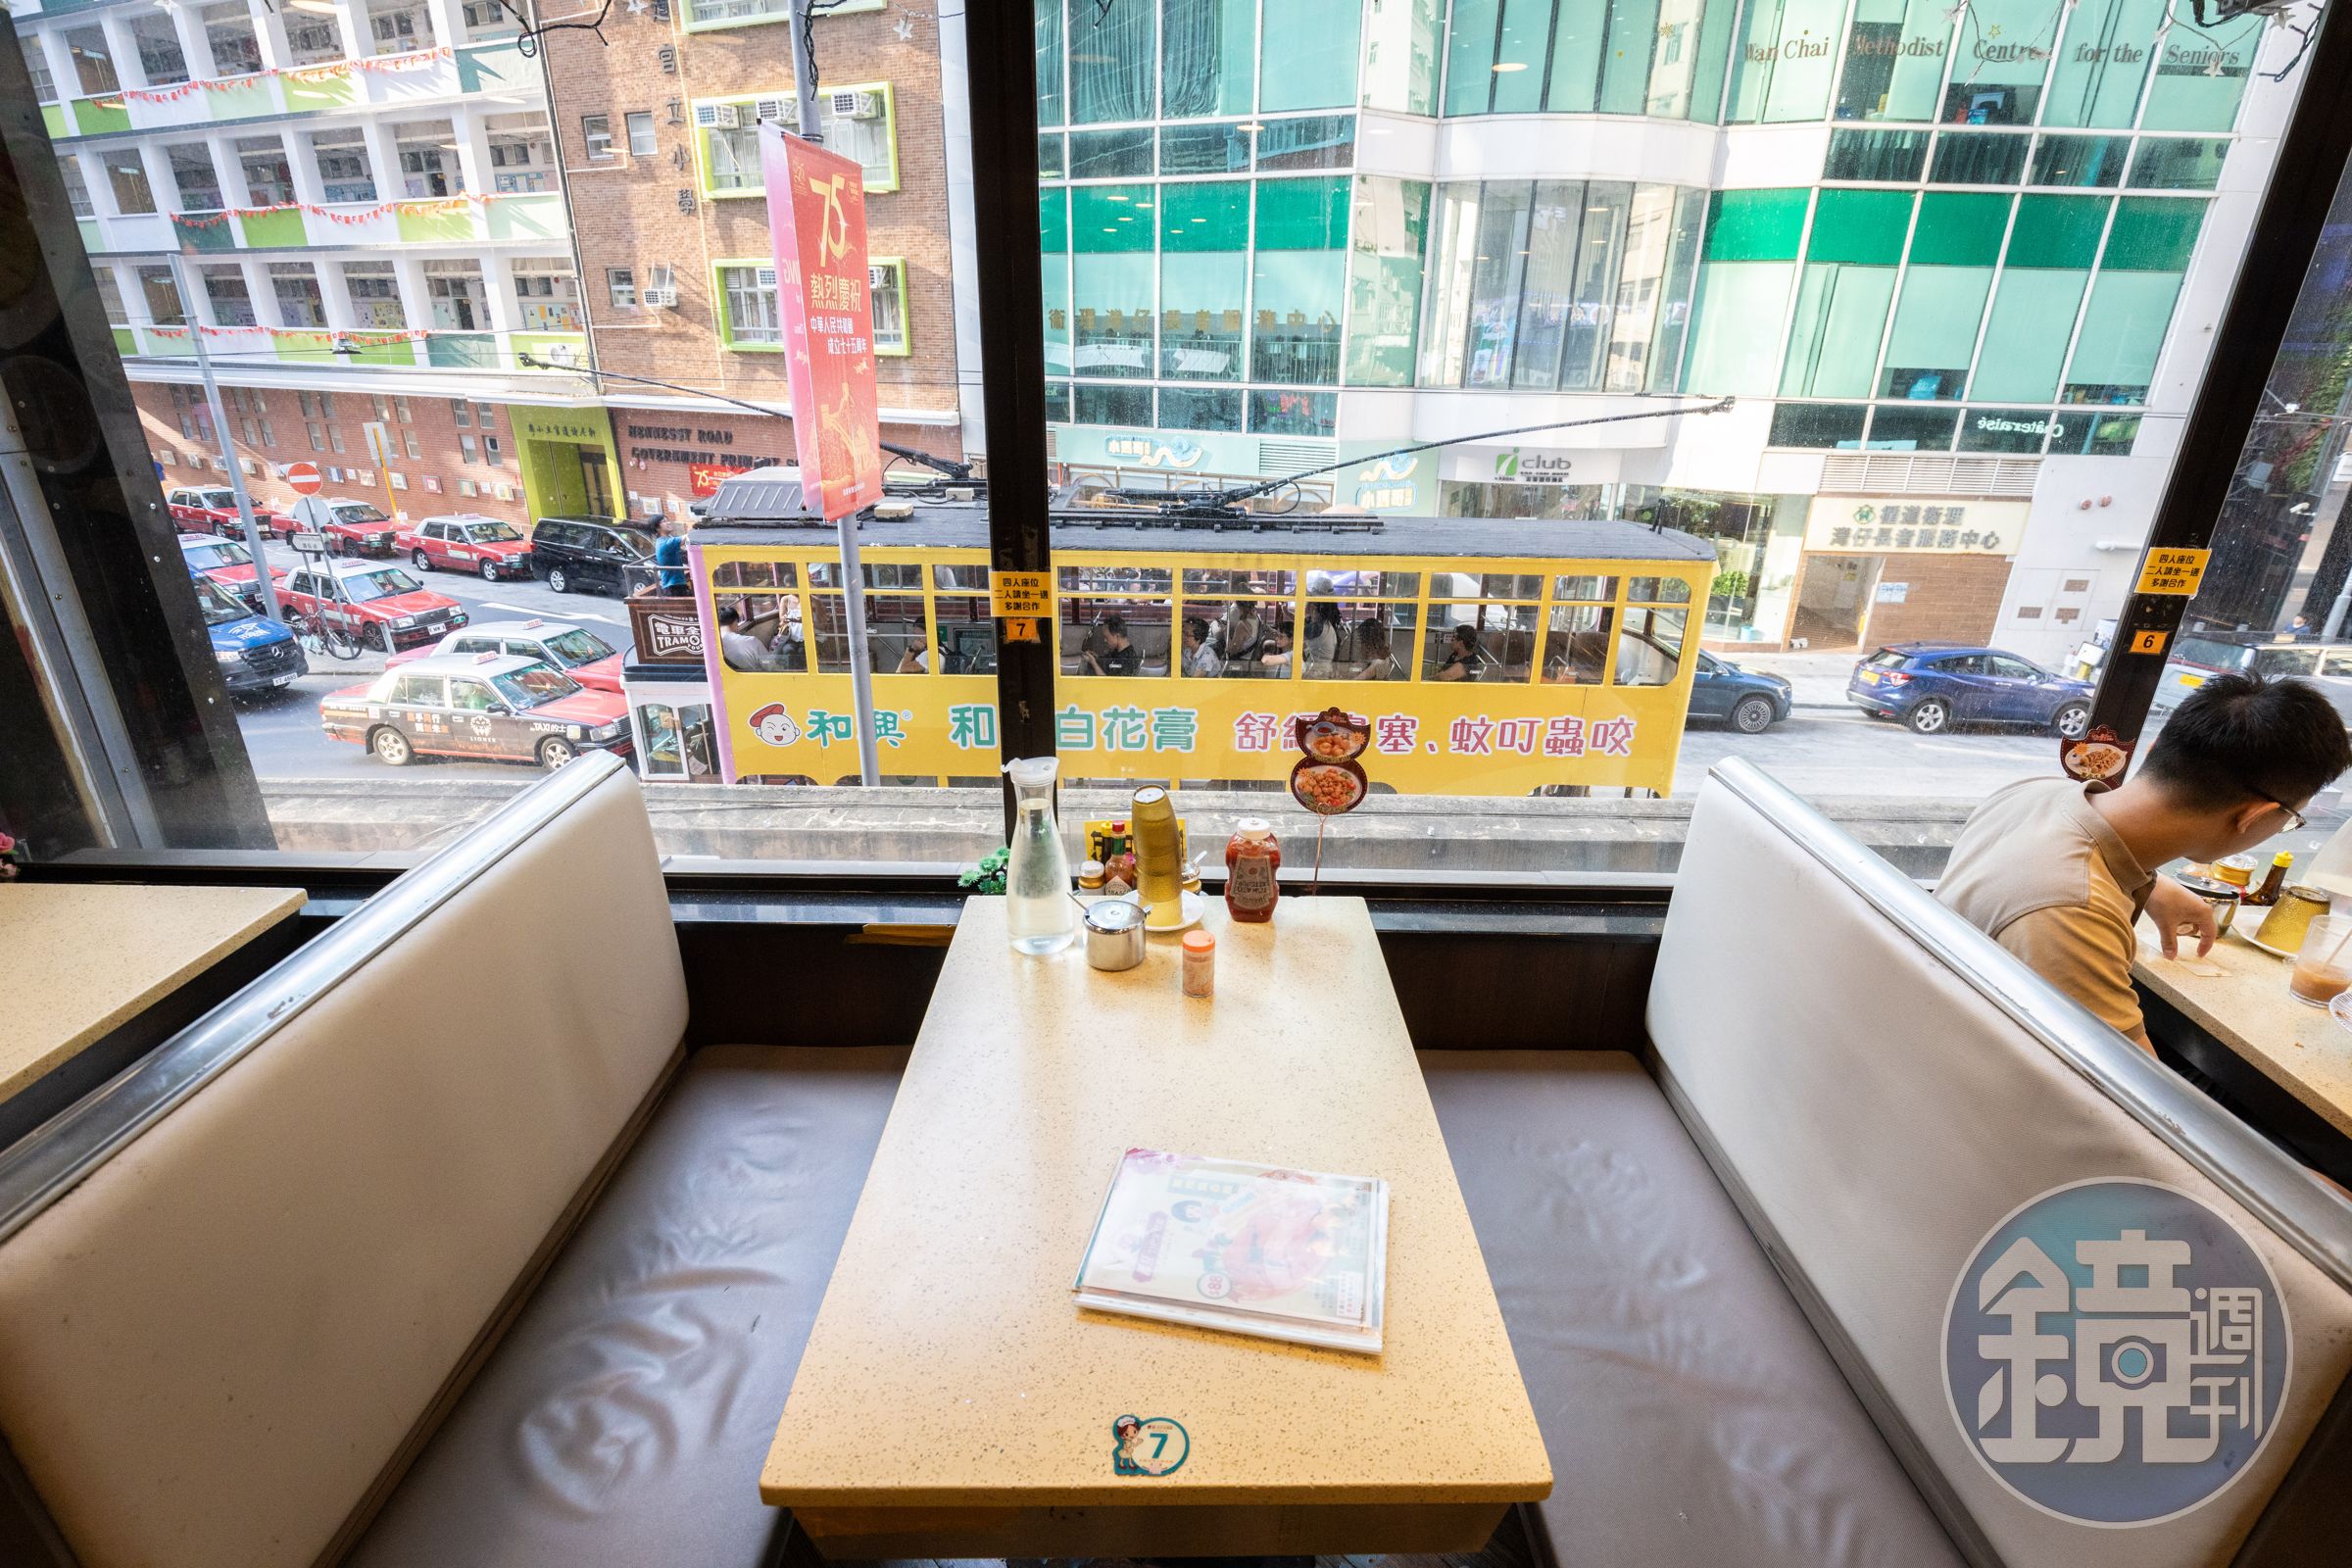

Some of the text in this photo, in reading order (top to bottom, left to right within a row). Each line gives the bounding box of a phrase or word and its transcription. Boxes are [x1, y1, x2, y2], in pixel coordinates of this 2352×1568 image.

[1745, 42, 1779, 64] Wan
[1784, 36, 1830, 60] Chai
[2075, 42, 2107, 63] for
[2113, 43, 2143, 64] the
[2165, 44, 2240, 66] Seniors
[808, 173, 846, 268] 75
[810, 272, 862, 313] 熱烈慶祝
[810, 315, 854, 334] 中華人民共和國
[697, 428, 733, 445] ROAD
[1880, 505, 1966, 526] 循道衛理
[1830, 526, 2000, 550] 灣仔長者服務中心
[2158, 554, 2196, 564] 四人座位
[1003, 577, 1039, 587] 四人座位
[2150, 578, 2187, 588] 多謝合作
[1004, 602, 1040, 612] 多謝合作
[1016, 623, 1026, 637] 7
[2142, 634, 2155, 649] 6
[951, 706, 1197, 751] 和白花膏
[1235, 713, 1637, 756] 舒塞、蚊叮蟲咬
[1150, 1433, 1168, 1458] 7
